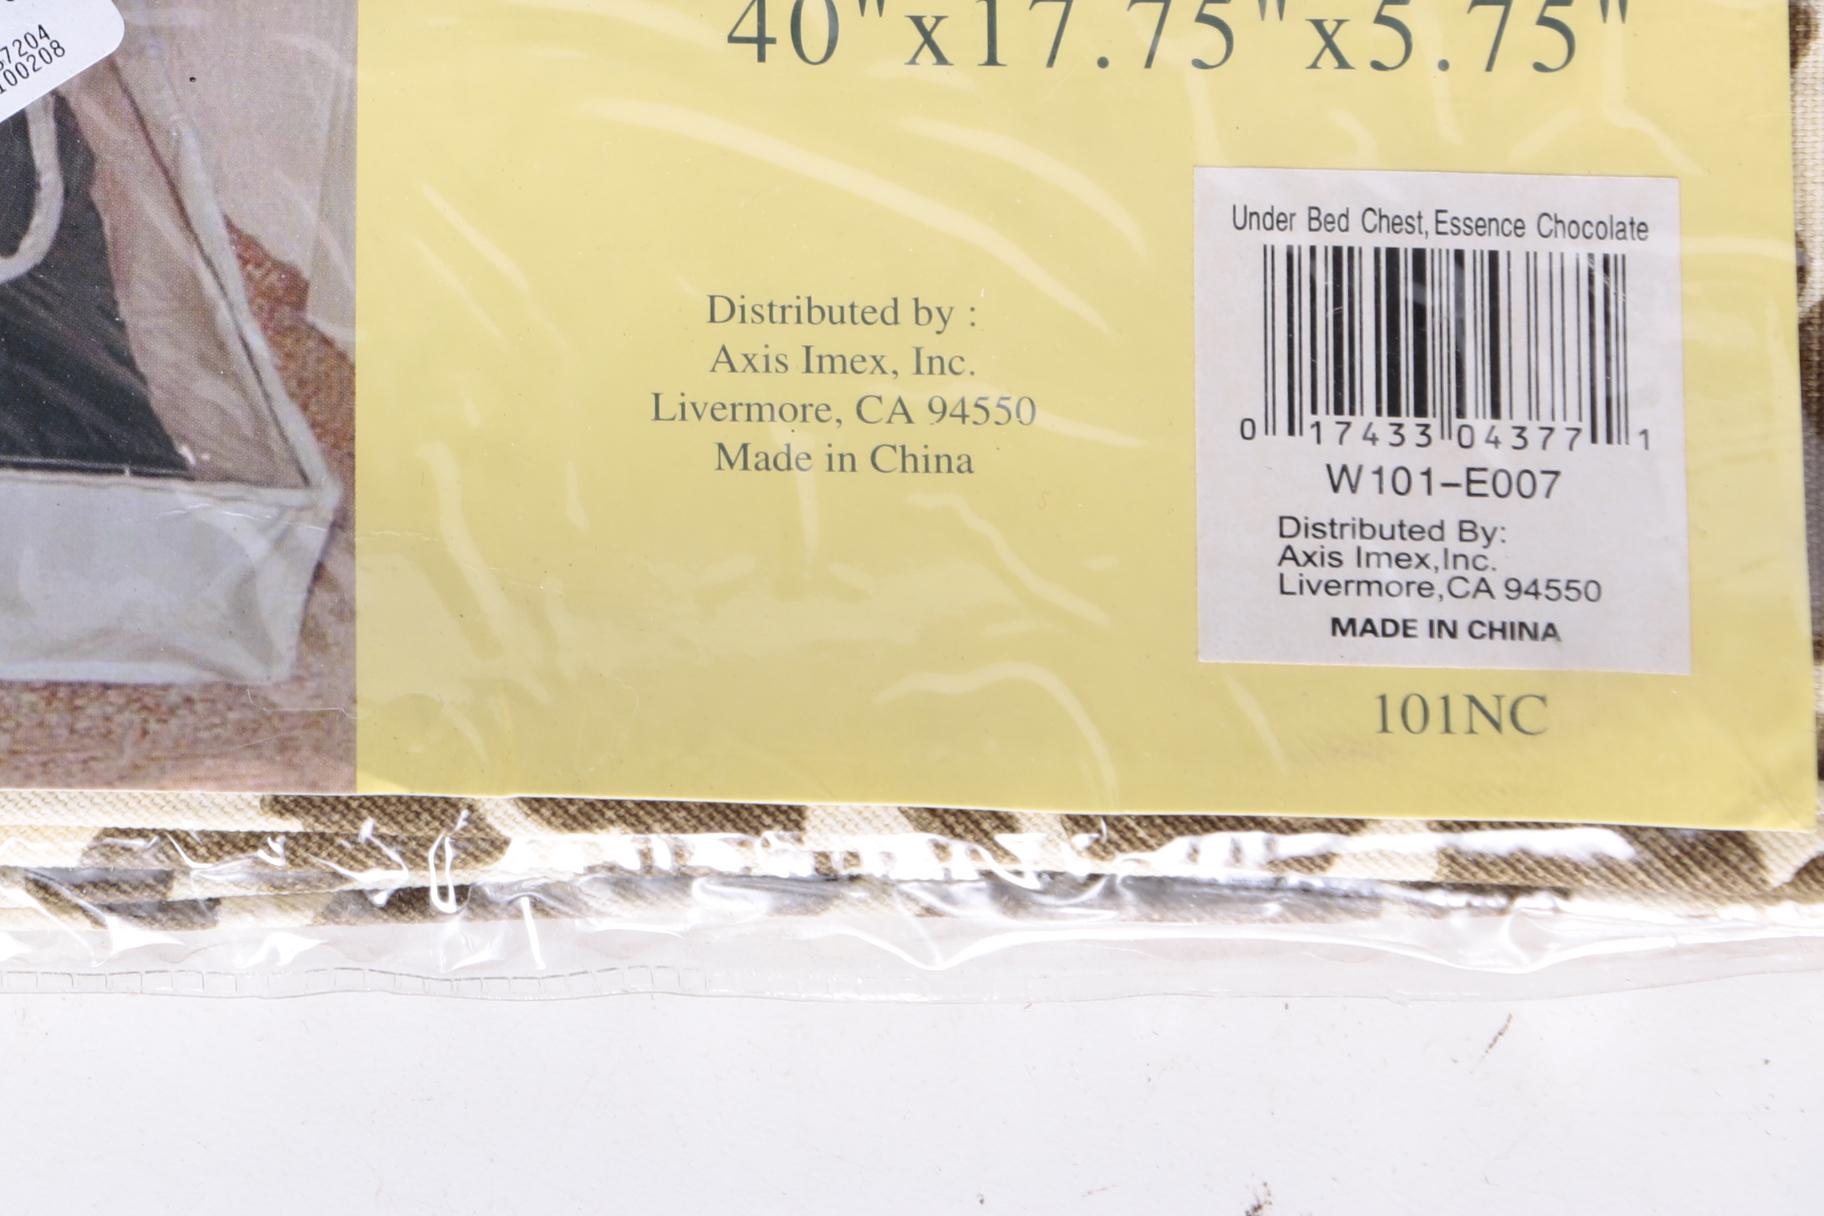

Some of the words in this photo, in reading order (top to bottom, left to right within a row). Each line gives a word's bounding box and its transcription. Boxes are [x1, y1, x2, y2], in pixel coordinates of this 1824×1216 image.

[1232, 205, 1296, 234] Under
[1307, 208, 1350, 234] Bed
[1536, 212, 1649, 242] Chocolate
[706, 293, 900, 327] Distributed
[913, 297, 955, 335] by
[709, 343, 789, 375] Axis
[801, 345, 899, 379] Imex,
[911, 346, 976, 377] Inc.
[650, 392, 843, 427] Livermore,
[855, 394, 915, 425] CA
[927, 395, 1037, 426] 94550
[714, 441, 813, 473] Made
[825, 444, 857, 473] in
[870, 444, 975, 475] China
[1325, 464, 1562, 499] W101-E007
[1278, 515, 1446, 543] Distributed
[1458, 520, 1507, 548] By:
[1277, 545, 1343, 569] Axis
[1505, 578, 1602, 602] 94550
[1330, 618, 1419, 639] MADE
[1428, 620, 1458, 639] IN
[1467, 620, 1562, 643] CHINA
[1374, 692, 1549, 737] 101NC
